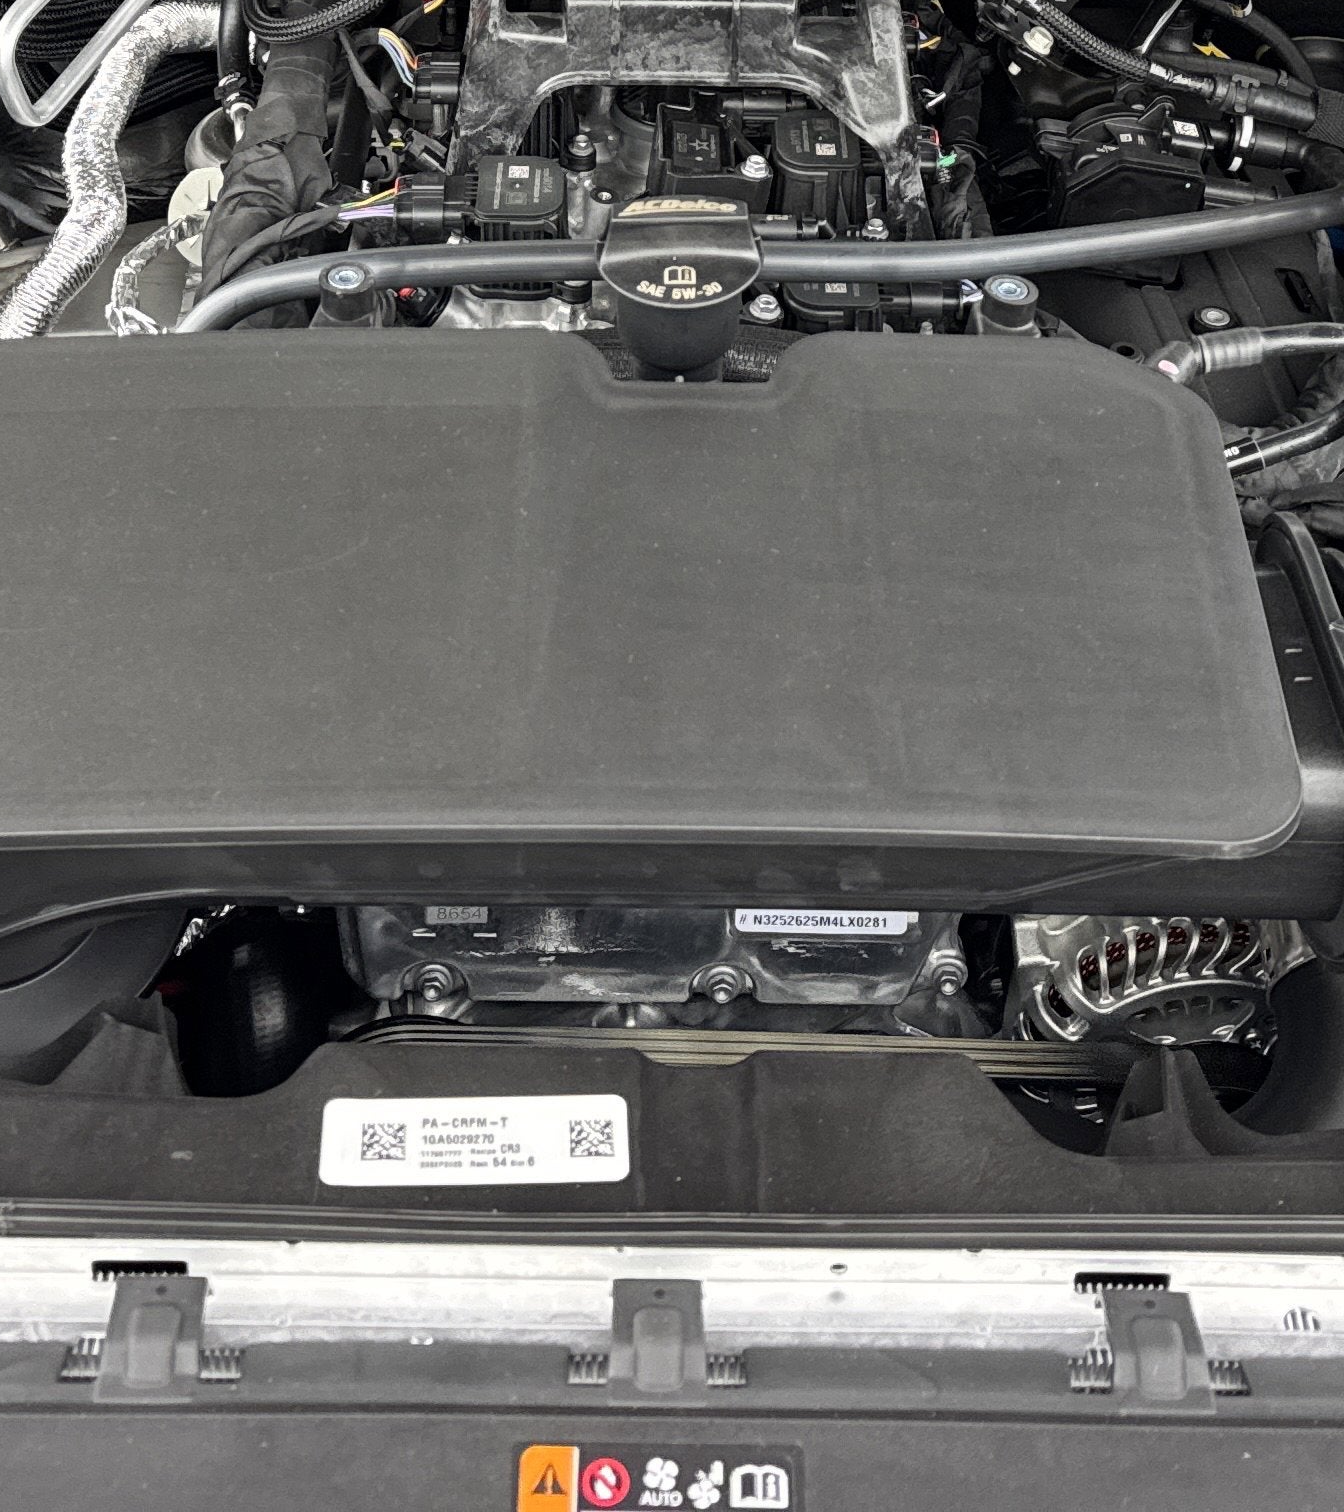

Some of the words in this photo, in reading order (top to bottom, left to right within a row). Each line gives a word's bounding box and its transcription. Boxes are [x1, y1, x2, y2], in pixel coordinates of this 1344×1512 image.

[624, 198, 738, 216] ACDelco
[636, 280, 665, 298] SAE
[671, 280, 723, 300] 5W-30
[436, 907, 482, 920] 8654
[753, 914, 887, 928] N3252625M4LX0281
[500, 1143, 521, 1154] CR3
[527, 1156, 535, 1167] 6
[638, 1490, 683, 1507] AUTO
